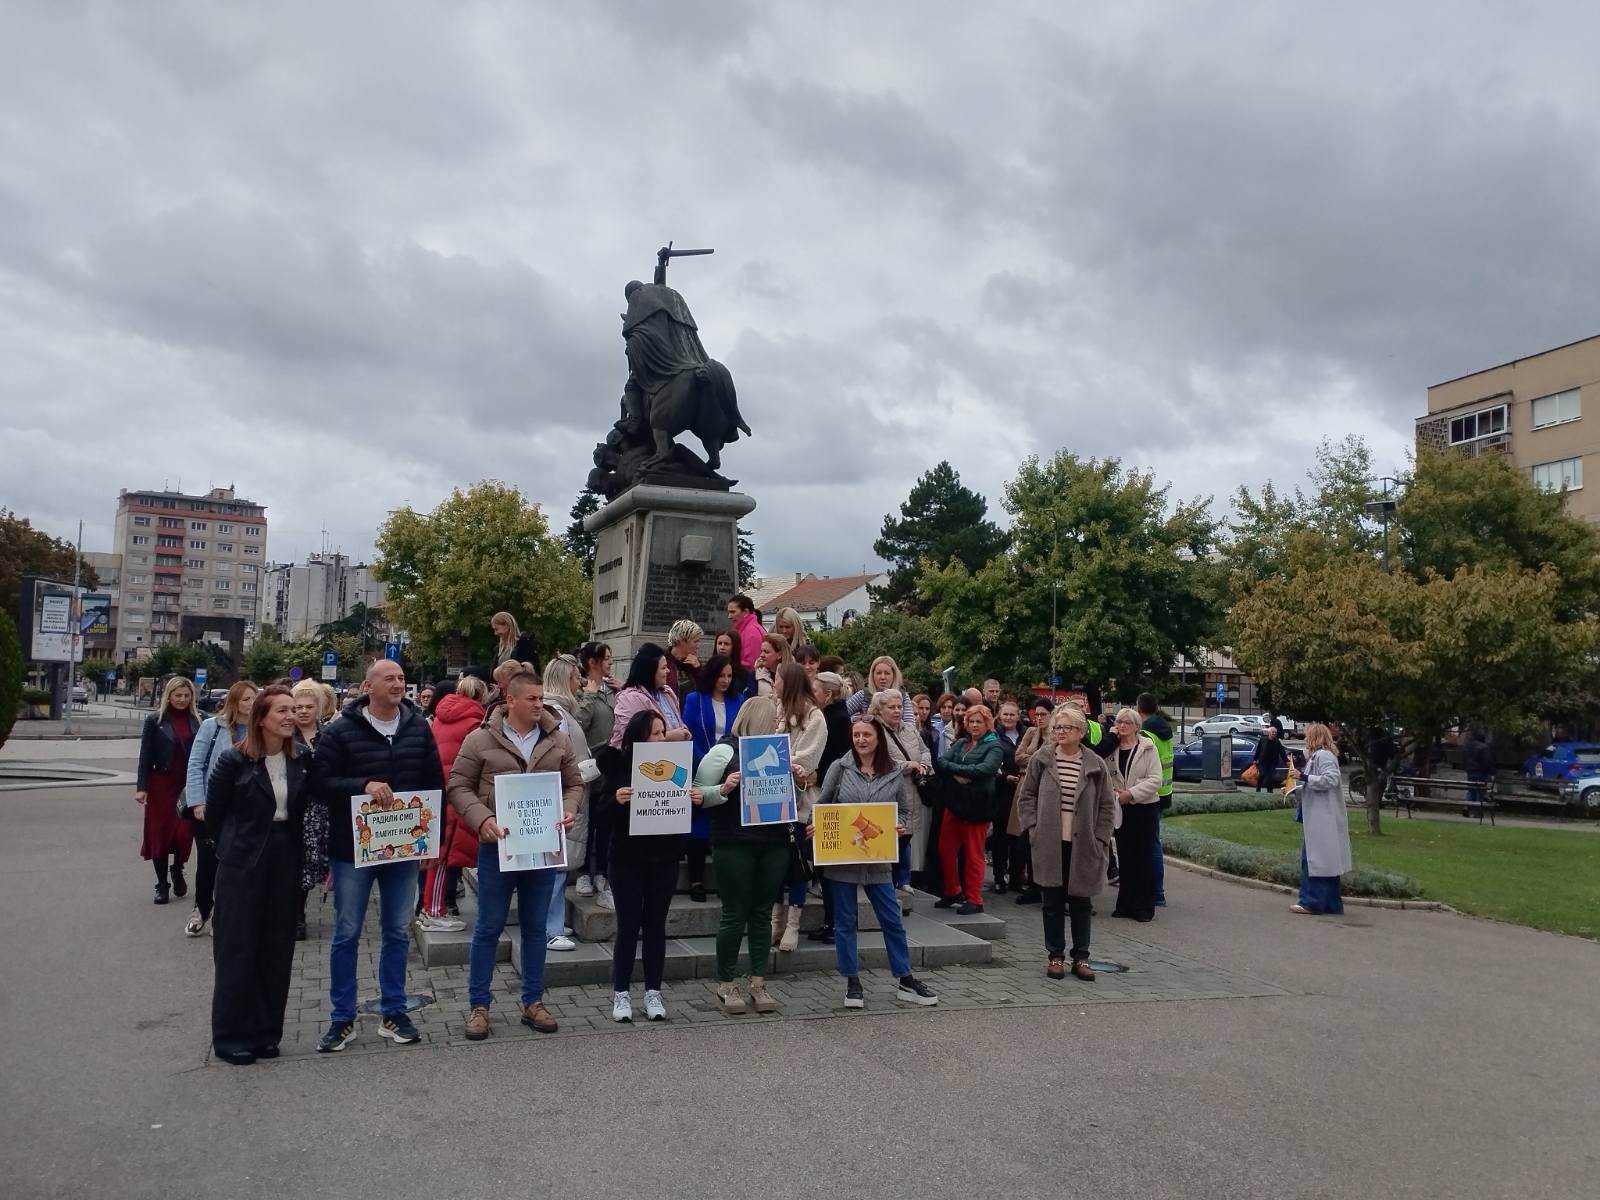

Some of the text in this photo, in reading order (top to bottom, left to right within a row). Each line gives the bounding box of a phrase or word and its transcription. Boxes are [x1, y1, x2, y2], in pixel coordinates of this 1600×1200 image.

[327, 654, 334, 664] P
[508, 798, 552, 809] MI SE BRINEMO
[373, 814, 398, 824] РАДИЛИ
[823, 822, 840, 830] RASTE
[824, 831, 840, 840] PLATE
